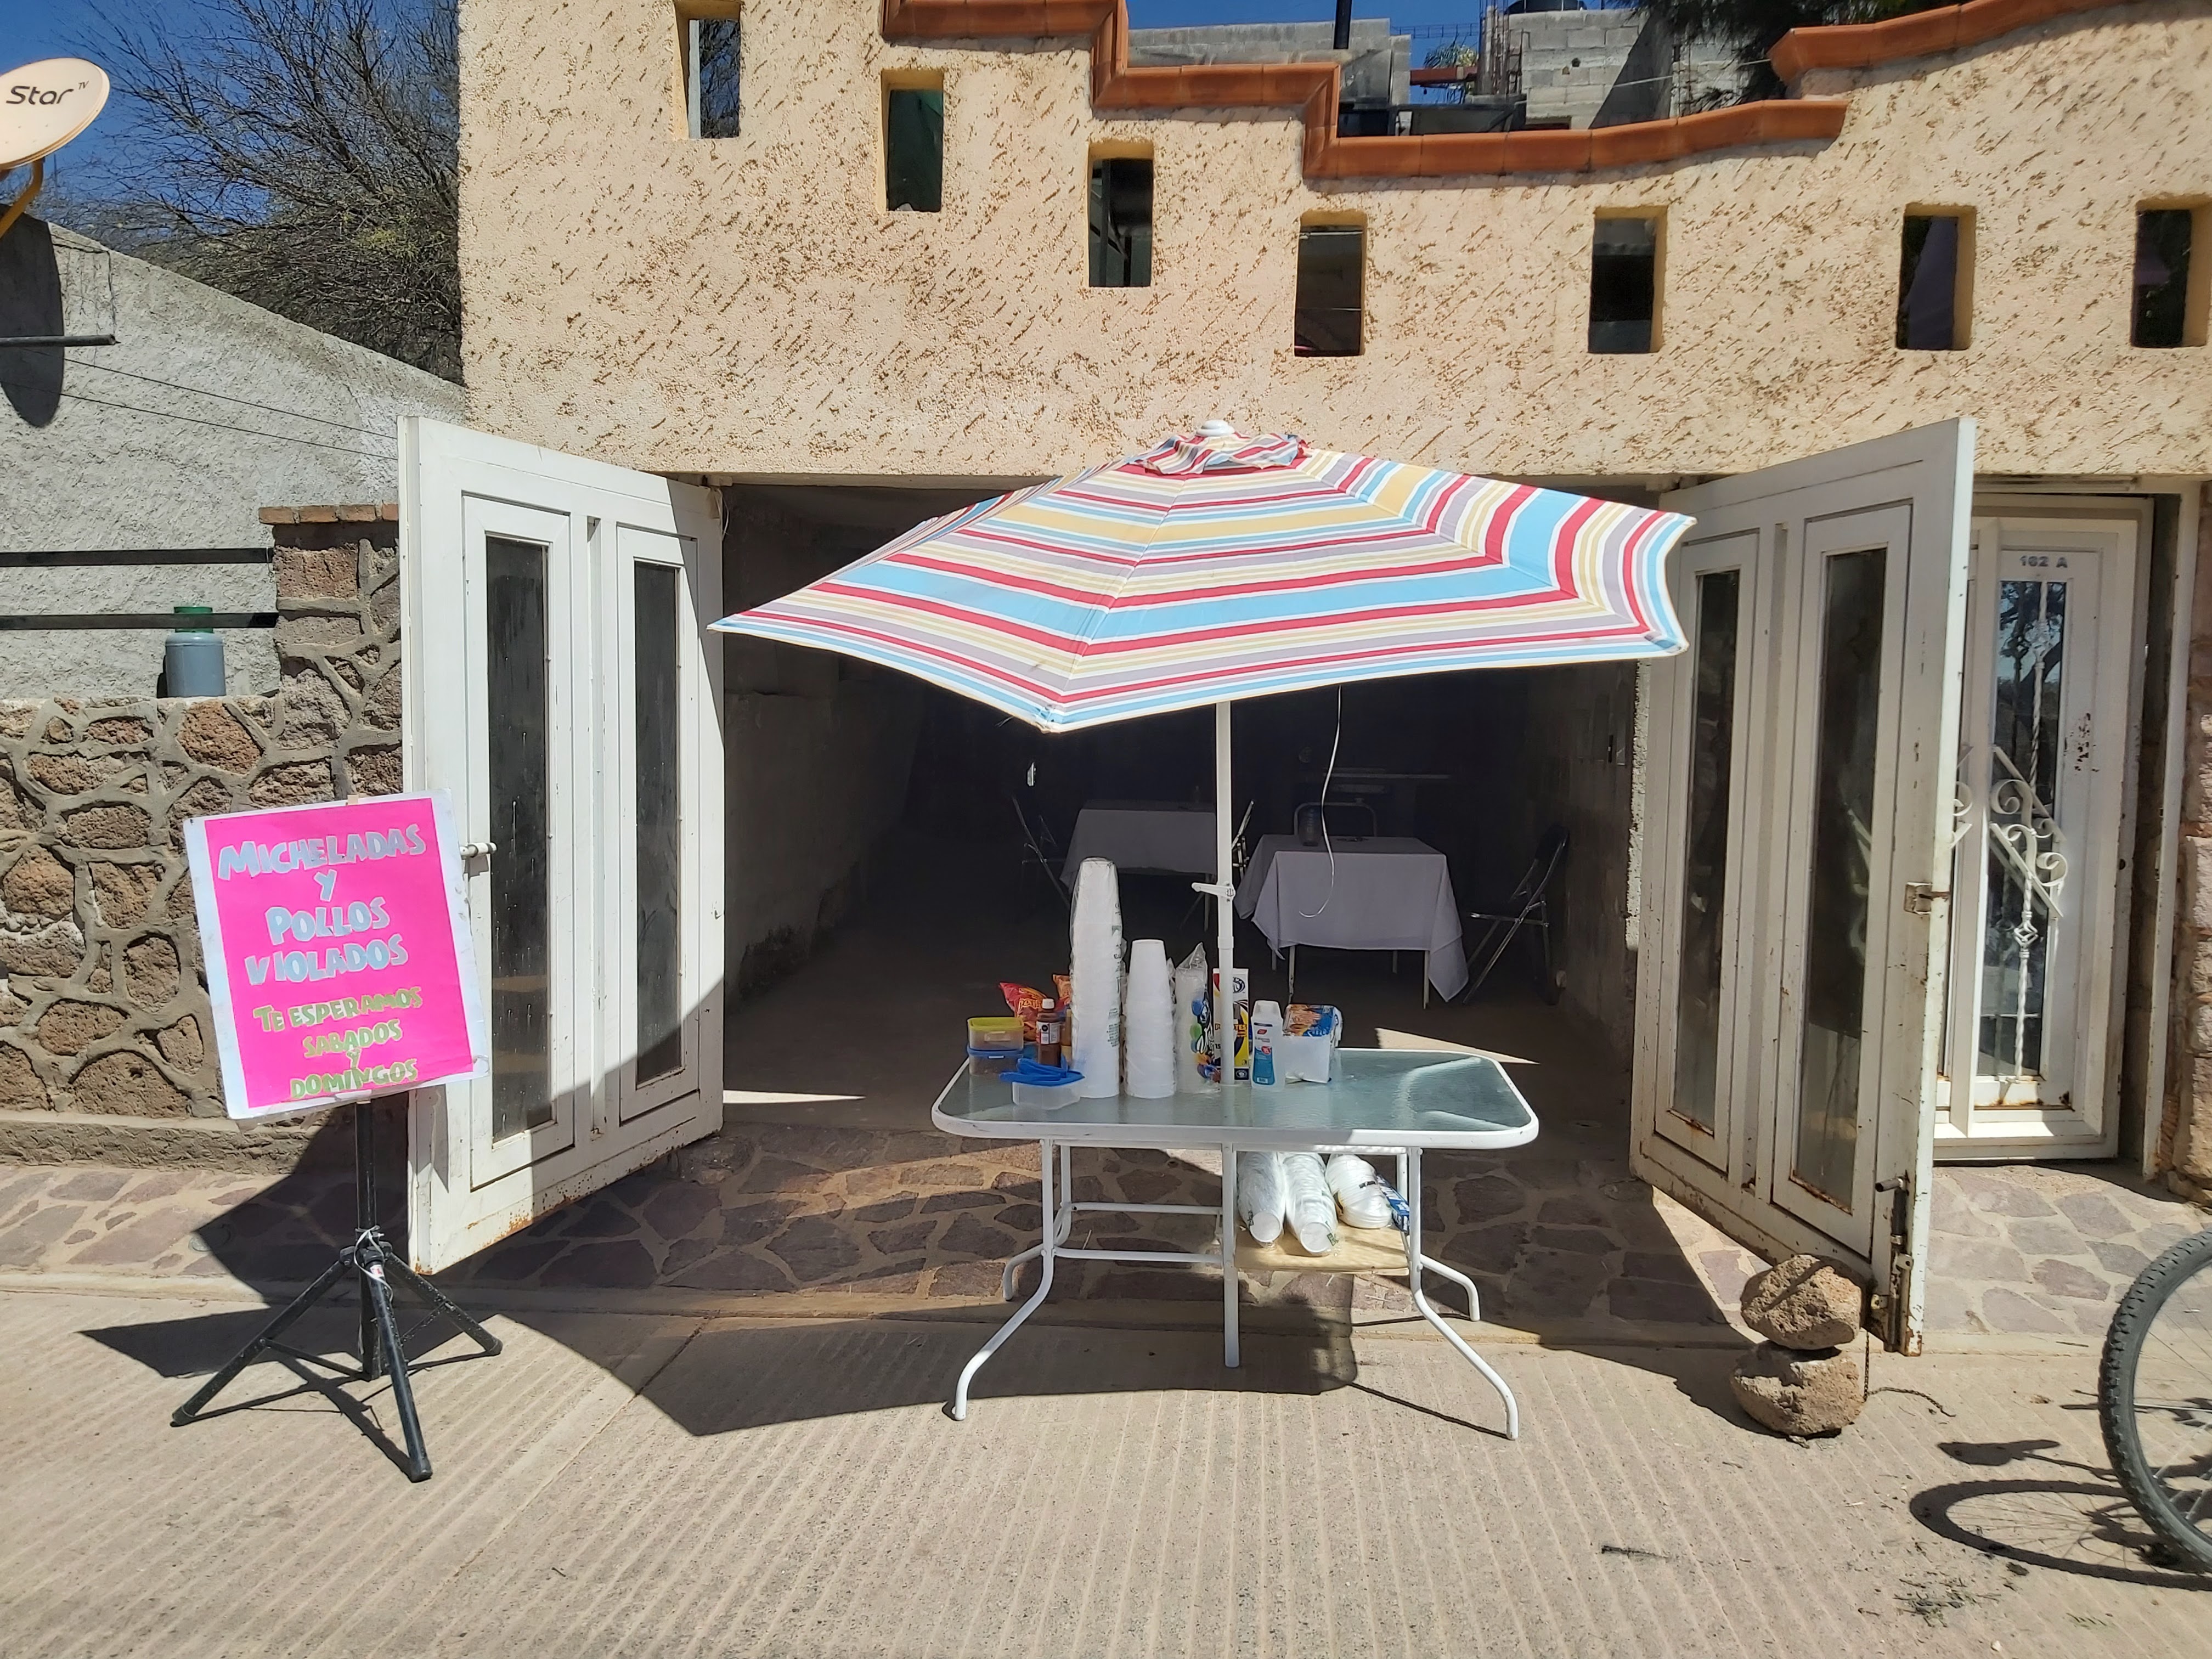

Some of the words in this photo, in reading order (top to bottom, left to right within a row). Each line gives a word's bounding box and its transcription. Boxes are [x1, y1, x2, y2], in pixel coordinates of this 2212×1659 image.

[6, 86, 74, 105] Star
[78, 81, 89, 90] TV
[2056, 557, 2068, 568] A
[218, 823, 426, 881] MICHELADAS
[314, 868, 337, 902] Y
[265, 896, 390, 945] POLLOS
[244, 933, 409, 985] VIOLADOS
[253, 1005, 285, 1032] TE
[289, 986, 423, 1026] ESPERAMOS
[302, 1018, 403, 1058] SABADOS
[290, 1058, 419, 1098] DOMINGOS
[346, 1048, 362, 1069] Y
